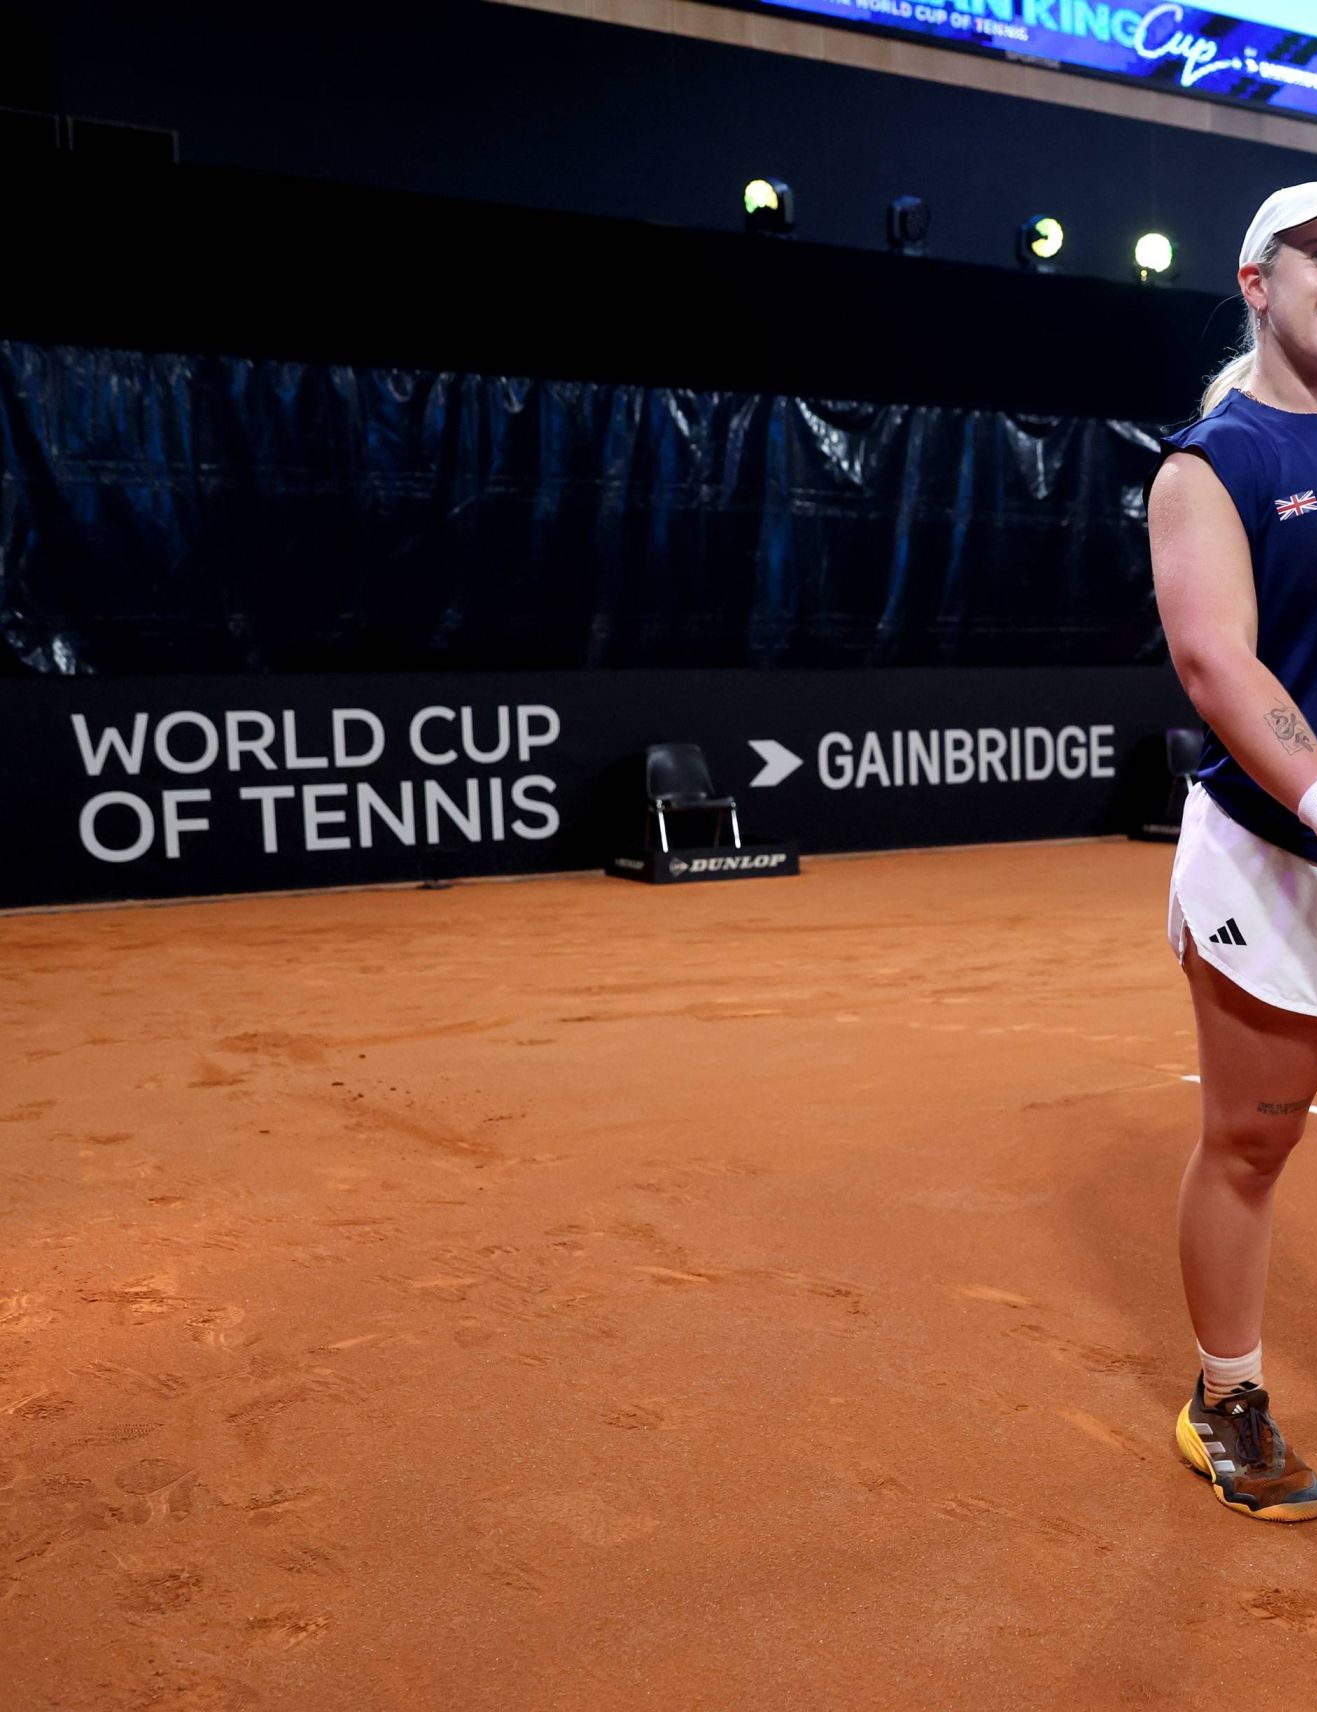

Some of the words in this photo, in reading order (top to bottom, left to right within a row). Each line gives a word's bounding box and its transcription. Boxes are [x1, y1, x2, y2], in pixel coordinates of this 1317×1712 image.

[914, 4, 948, 25] CUP
[950, 11, 971, 31] OF
[1022, 0, 1148, 49] KING
[1134, 3, 1236, 87] Cup
[71, 708, 386, 776] WORLD
[409, 704, 561, 765] CUP
[817, 724, 1116, 790] GAINBRIDGE
[79, 788, 212, 863] OF
[239, 774, 560, 854] TENNIS
[689, 853, 787, 873] DUNLOP
